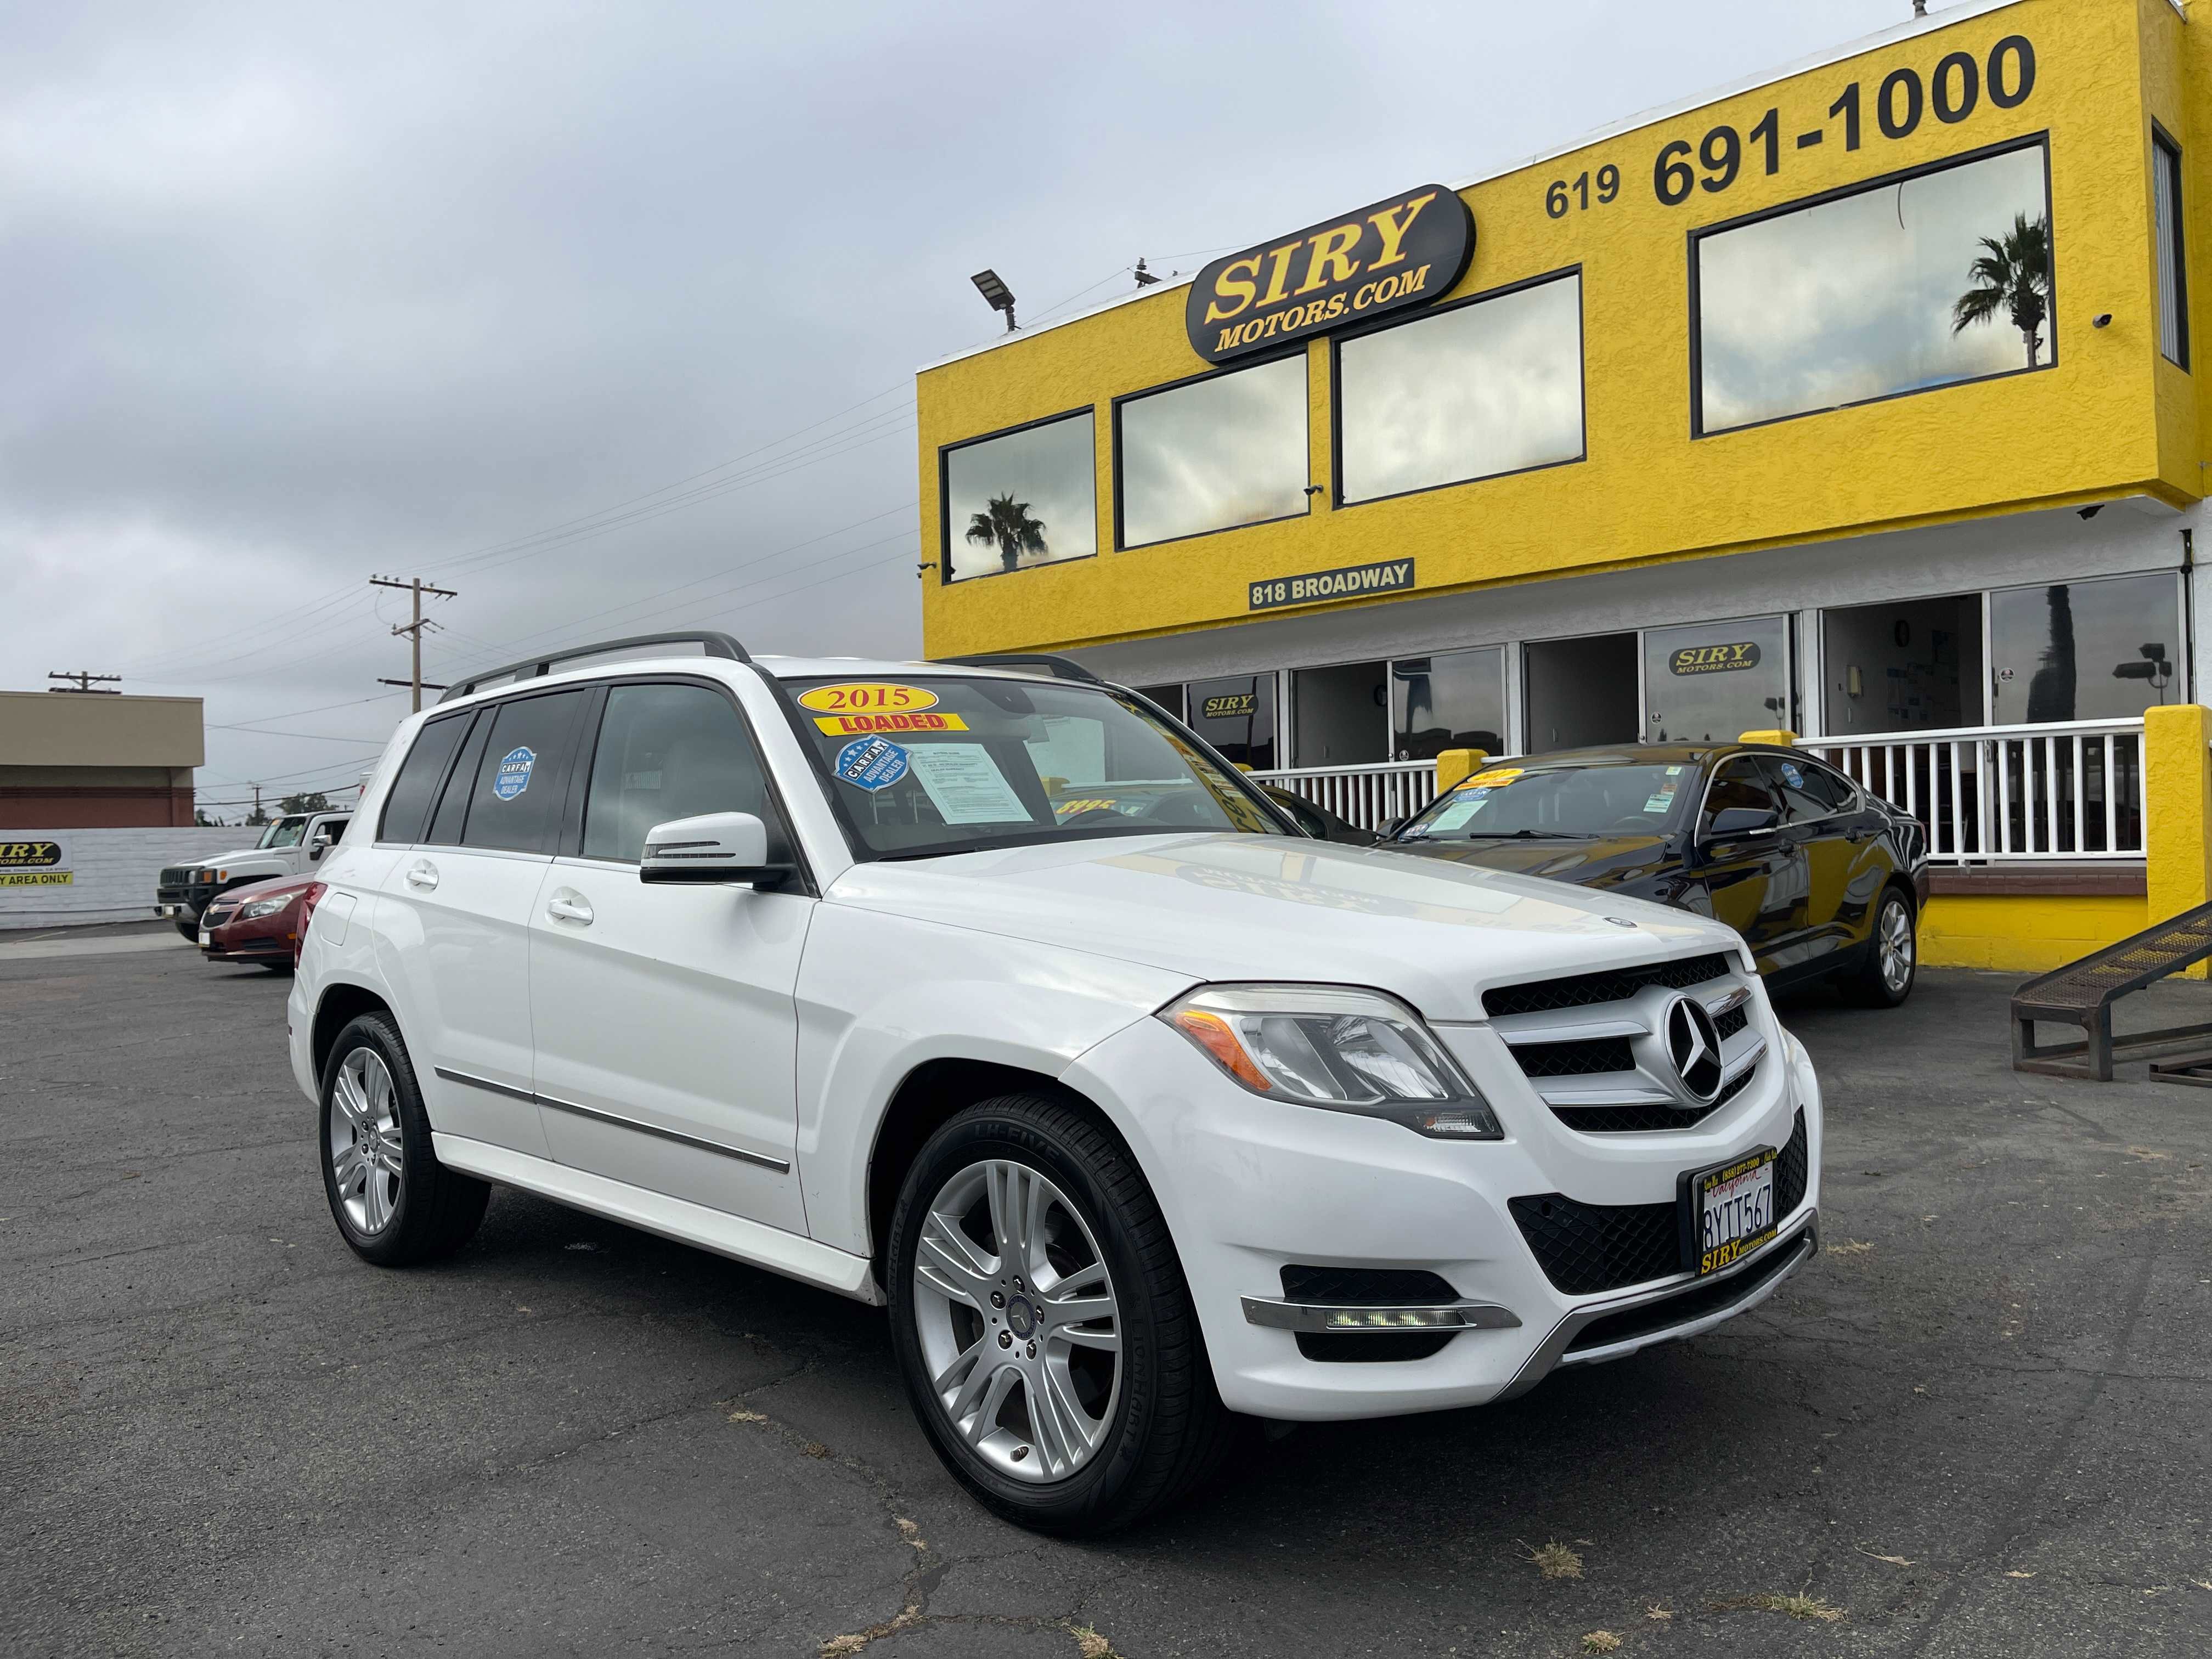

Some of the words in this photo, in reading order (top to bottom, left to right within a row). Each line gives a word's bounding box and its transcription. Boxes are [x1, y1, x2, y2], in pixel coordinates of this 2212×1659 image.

[1545, 164, 1620, 218] 619
[1654, 35, 2036, 206] 691-1000
[1205, 191, 1437, 325] SIRY
[1215, 264, 1430, 352] MOTORS.COM
[1252, 583, 1285, 605] 818
[1292, 563, 1408, 599] BROADWAY
[1676, 643, 1753, 666] SIRY
[1677, 661, 1753, 673] MOTORS.COM
[827, 689, 910, 709] 2015
[1205, 694, 1254, 712] SIRY
[838, 714, 948, 733] LOADED
[1206, 708, 1254, 718] MOTORS.COM
[502, 762, 531, 773] CARFAX
[848, 742, 888, 777] CARFAX
[864, 749, 898, 783] ADVANTAGE
[879, 759, 905, 782] DEALER
[500, 775, 526, 785] ADVANTAGE
[501, 785, 518, 794] DEALER
[9, 876, 38, 884] AREA
[1712, 1170, 1762, 1198] California
[1739, 1230, 1777, 1256] MOTORS.COM
[1701, 1239, 1741, 1275] SIRY
